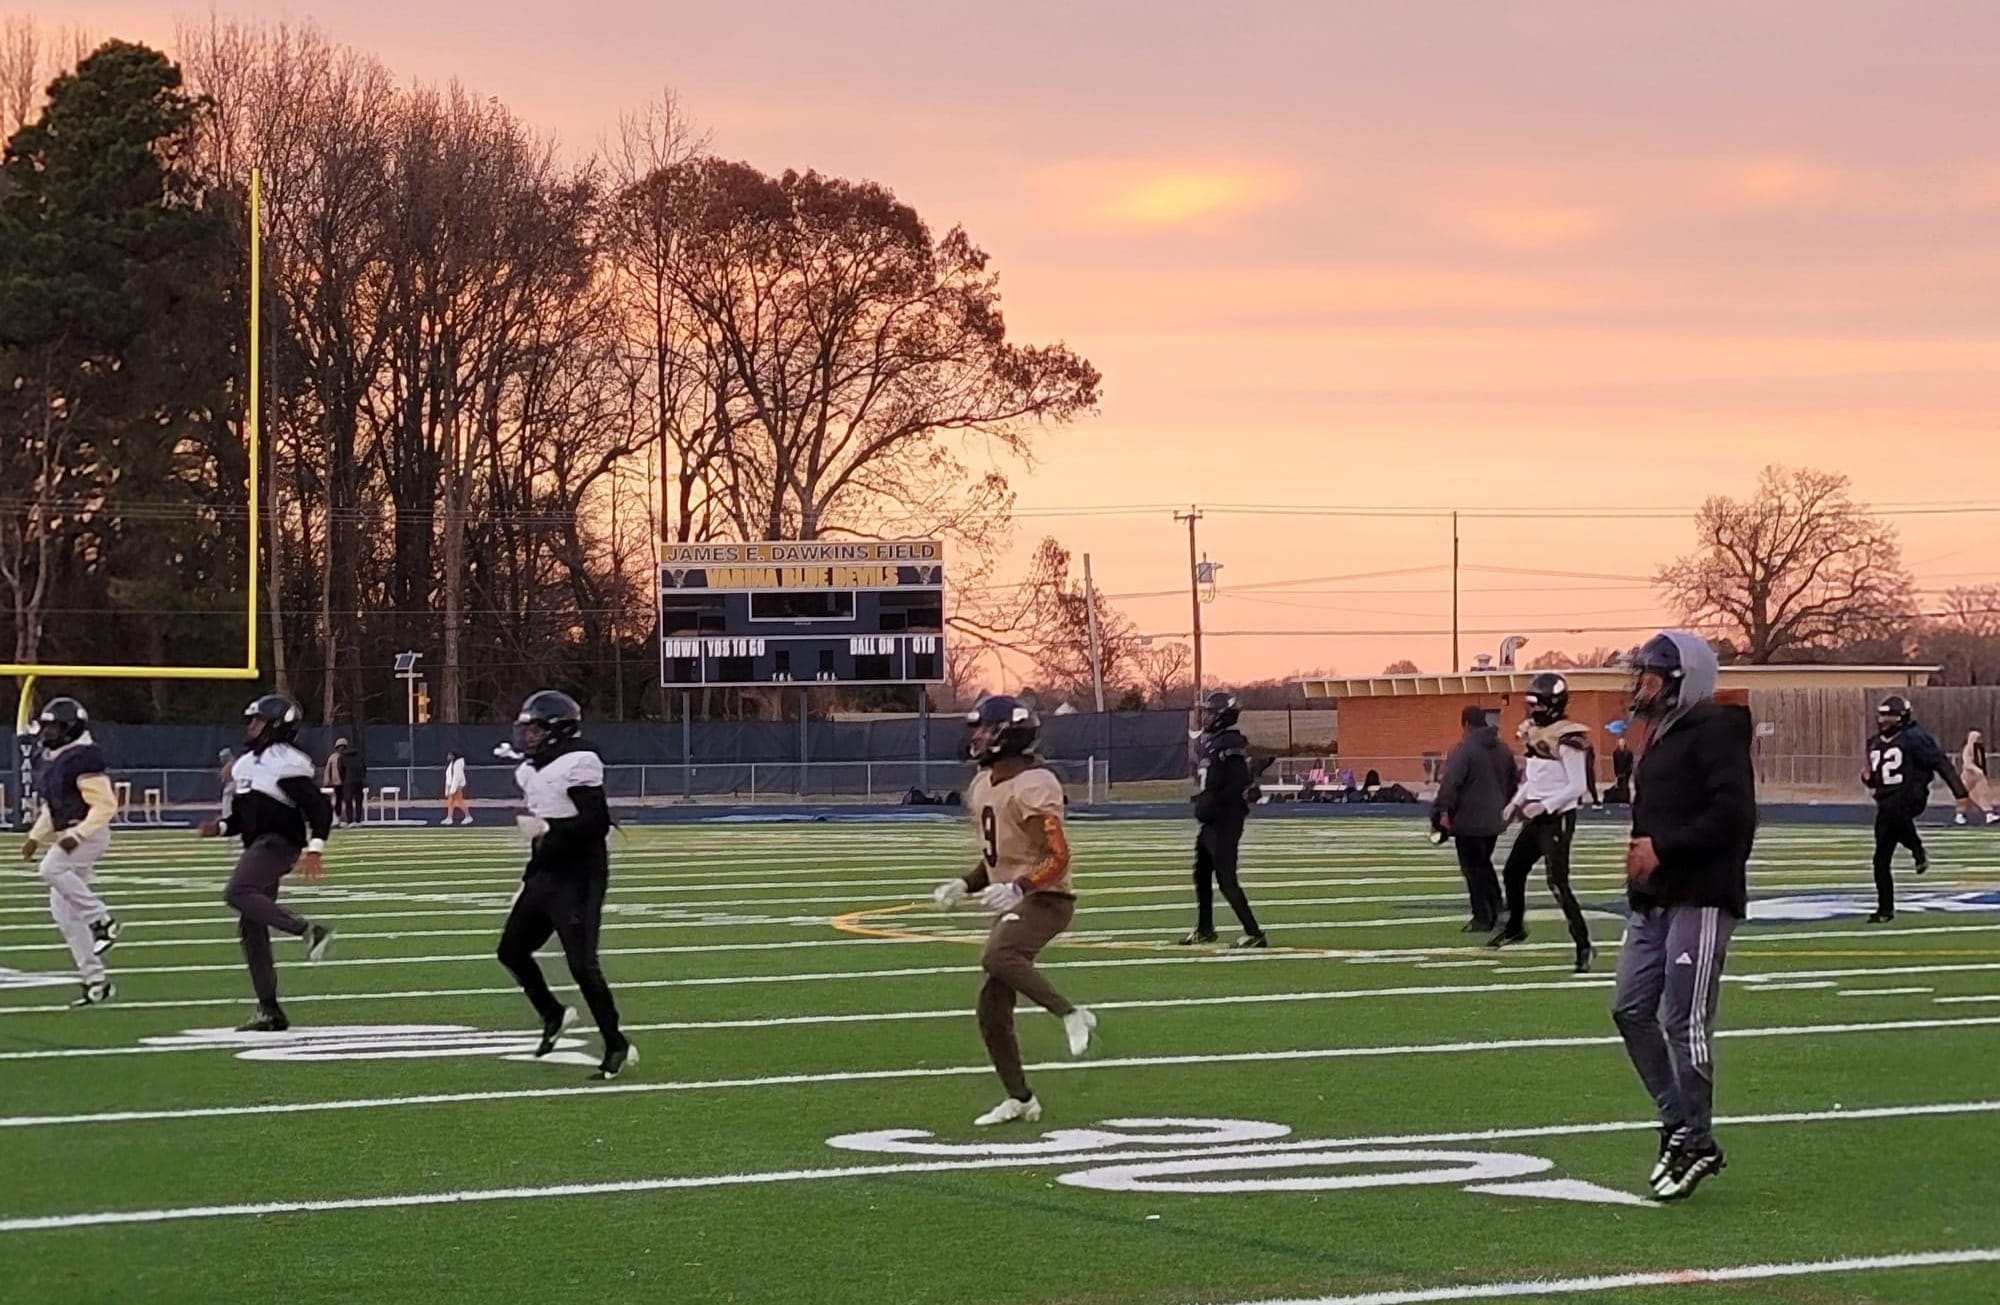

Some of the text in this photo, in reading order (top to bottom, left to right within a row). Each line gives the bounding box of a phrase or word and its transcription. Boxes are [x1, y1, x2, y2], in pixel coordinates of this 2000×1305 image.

[667, 544, 934, 562] JAMES E. DAWKINS FIELD
[705, 566, 899, 588] VARINA BLUE DEVILS
[665, 640, 699, 658] DOWN
[707, 639, 731, 657] YDS
[732, 639, 748, 657] TO
[749, 639, 766, 656] GO
[850, 638, 875, 655] BALL
[878, 638, 895, 654] ON
[1870, 747, 1903, 785] 72
[981, 805, 997, 868] 9
